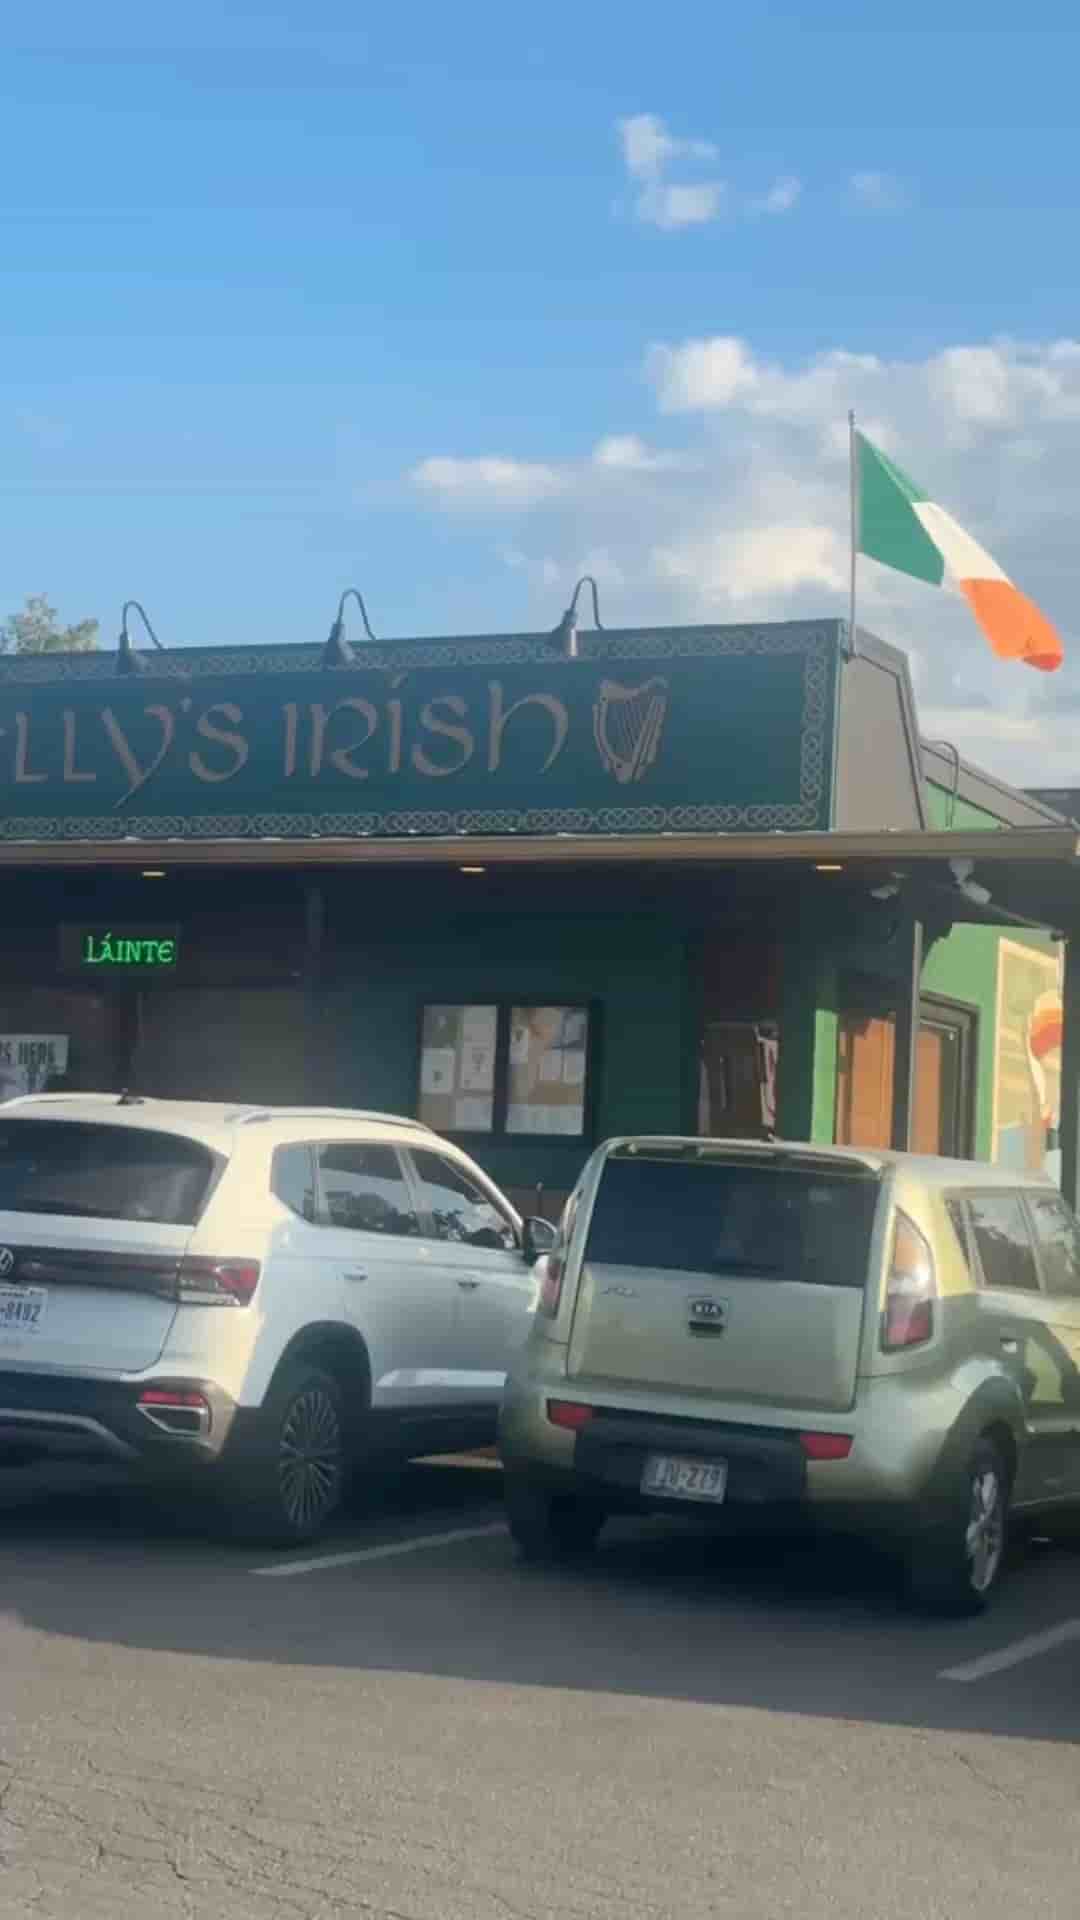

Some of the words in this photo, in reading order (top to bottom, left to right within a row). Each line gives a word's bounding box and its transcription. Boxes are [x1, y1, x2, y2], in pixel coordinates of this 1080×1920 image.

[0, 697, 250, 808] LLY'S
[85, 931, 174, 963] LÁINTE
[694, 1301, 719, 1315] KIA
